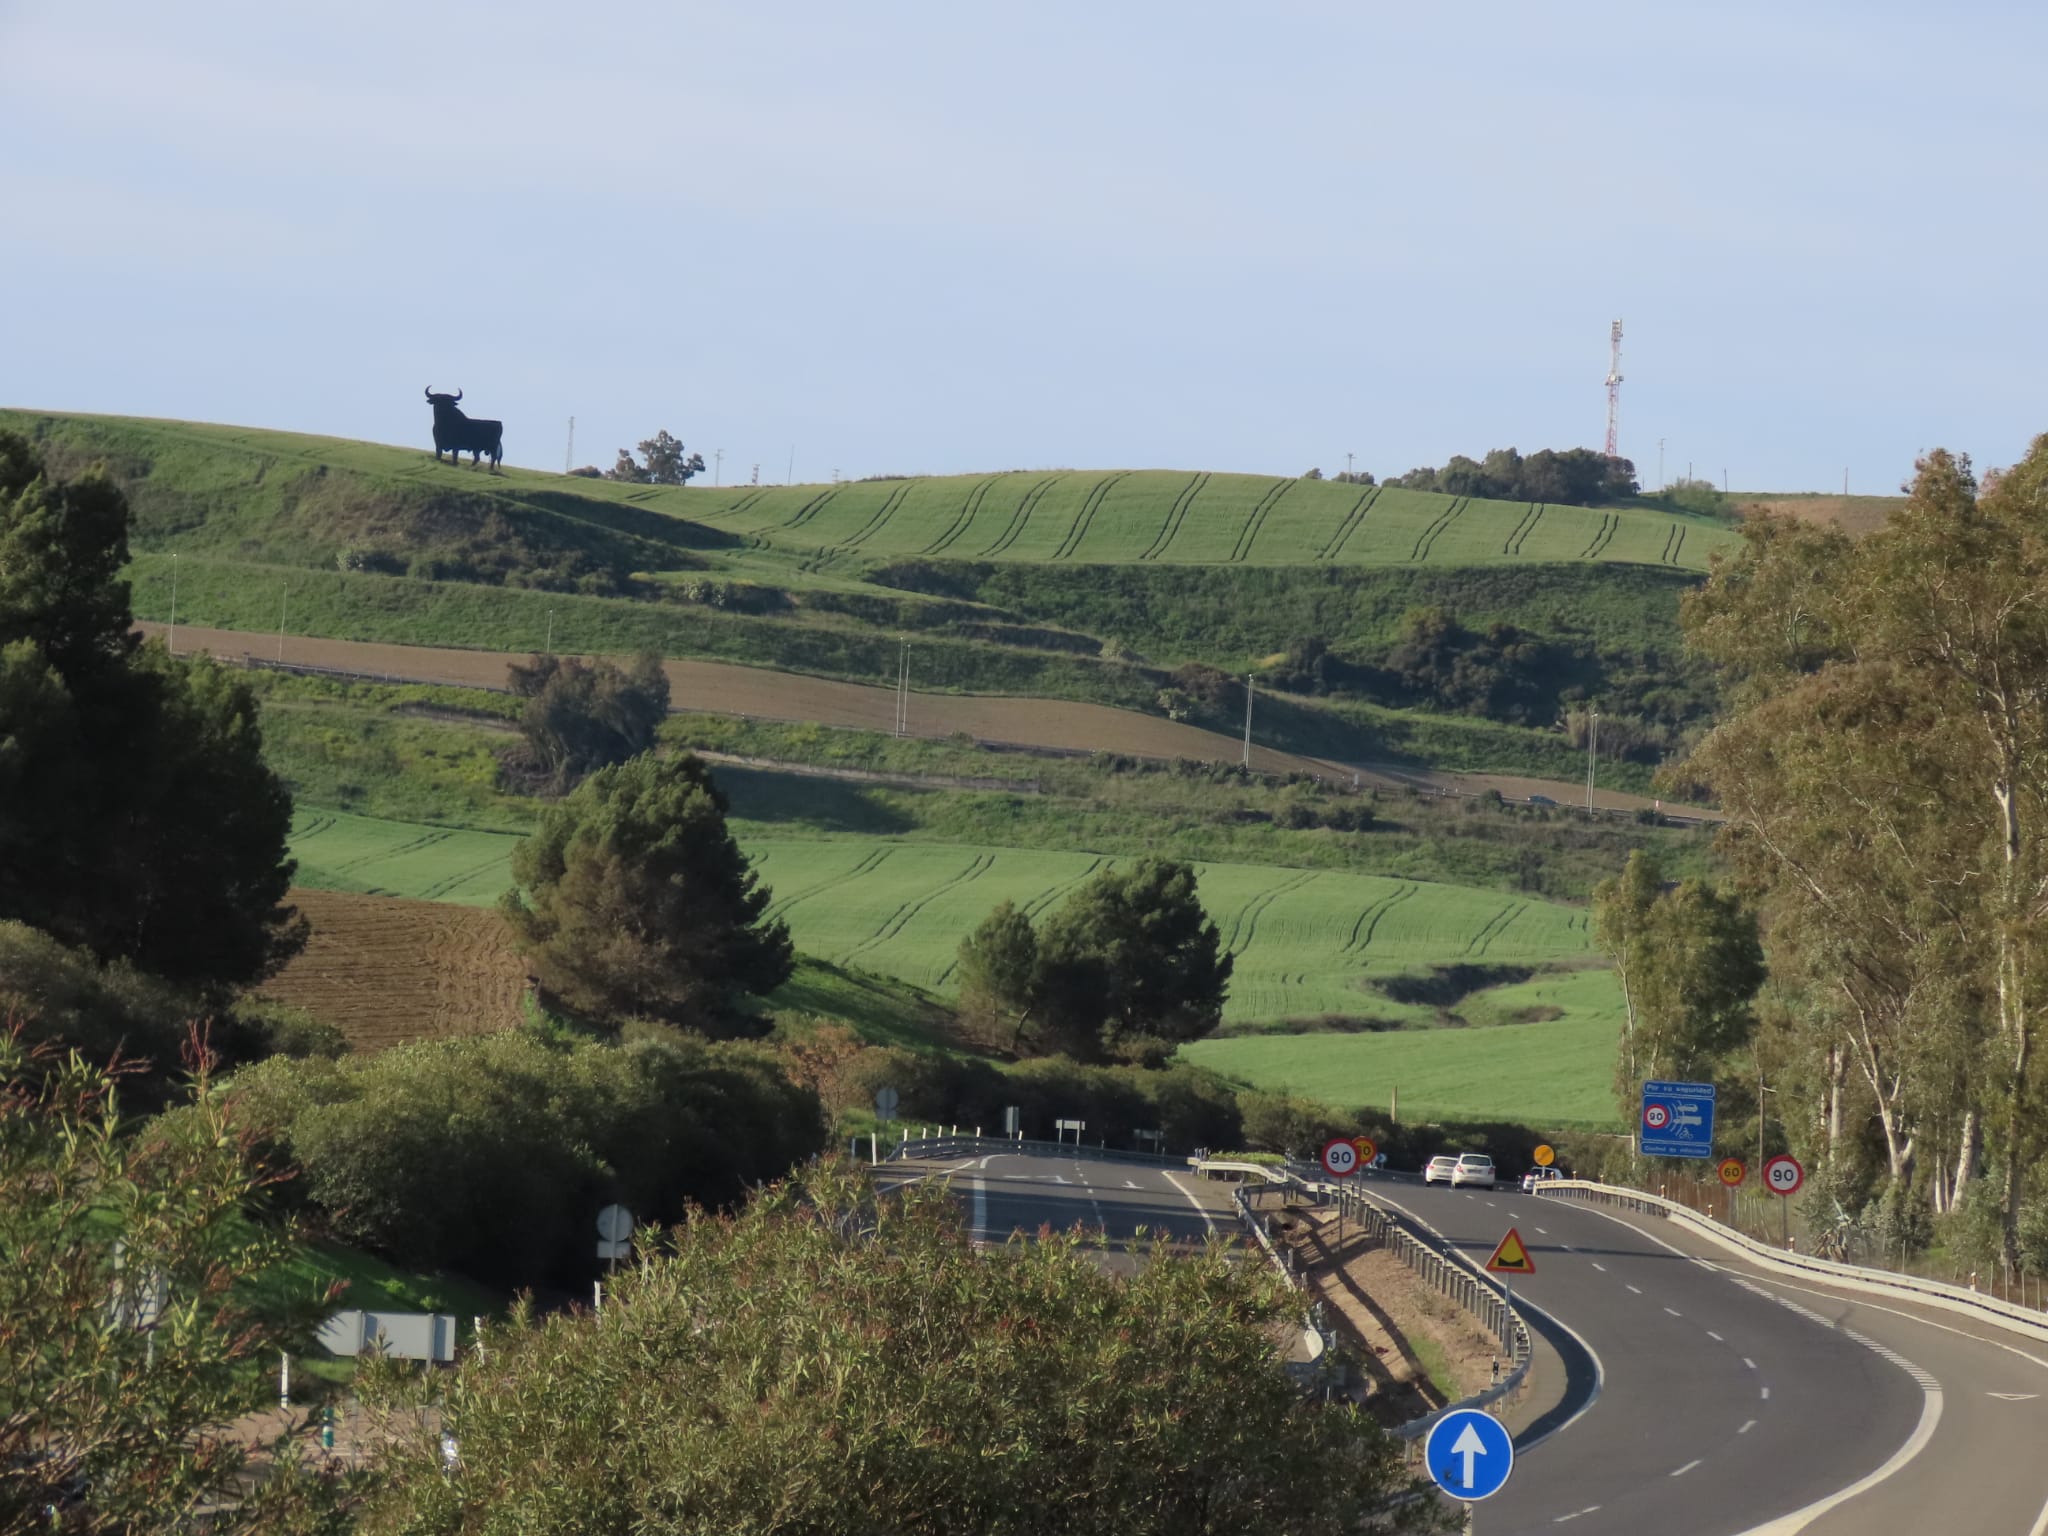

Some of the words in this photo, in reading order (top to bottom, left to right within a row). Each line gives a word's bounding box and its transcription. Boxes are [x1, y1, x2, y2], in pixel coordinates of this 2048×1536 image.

[1649, 1112, 1663, 1121] 90
[1330, 1151, 1352, 1164] 90
[1724, 1167, 1740, 1177] 60
[1773, 1169, 1794, 1182] 90
